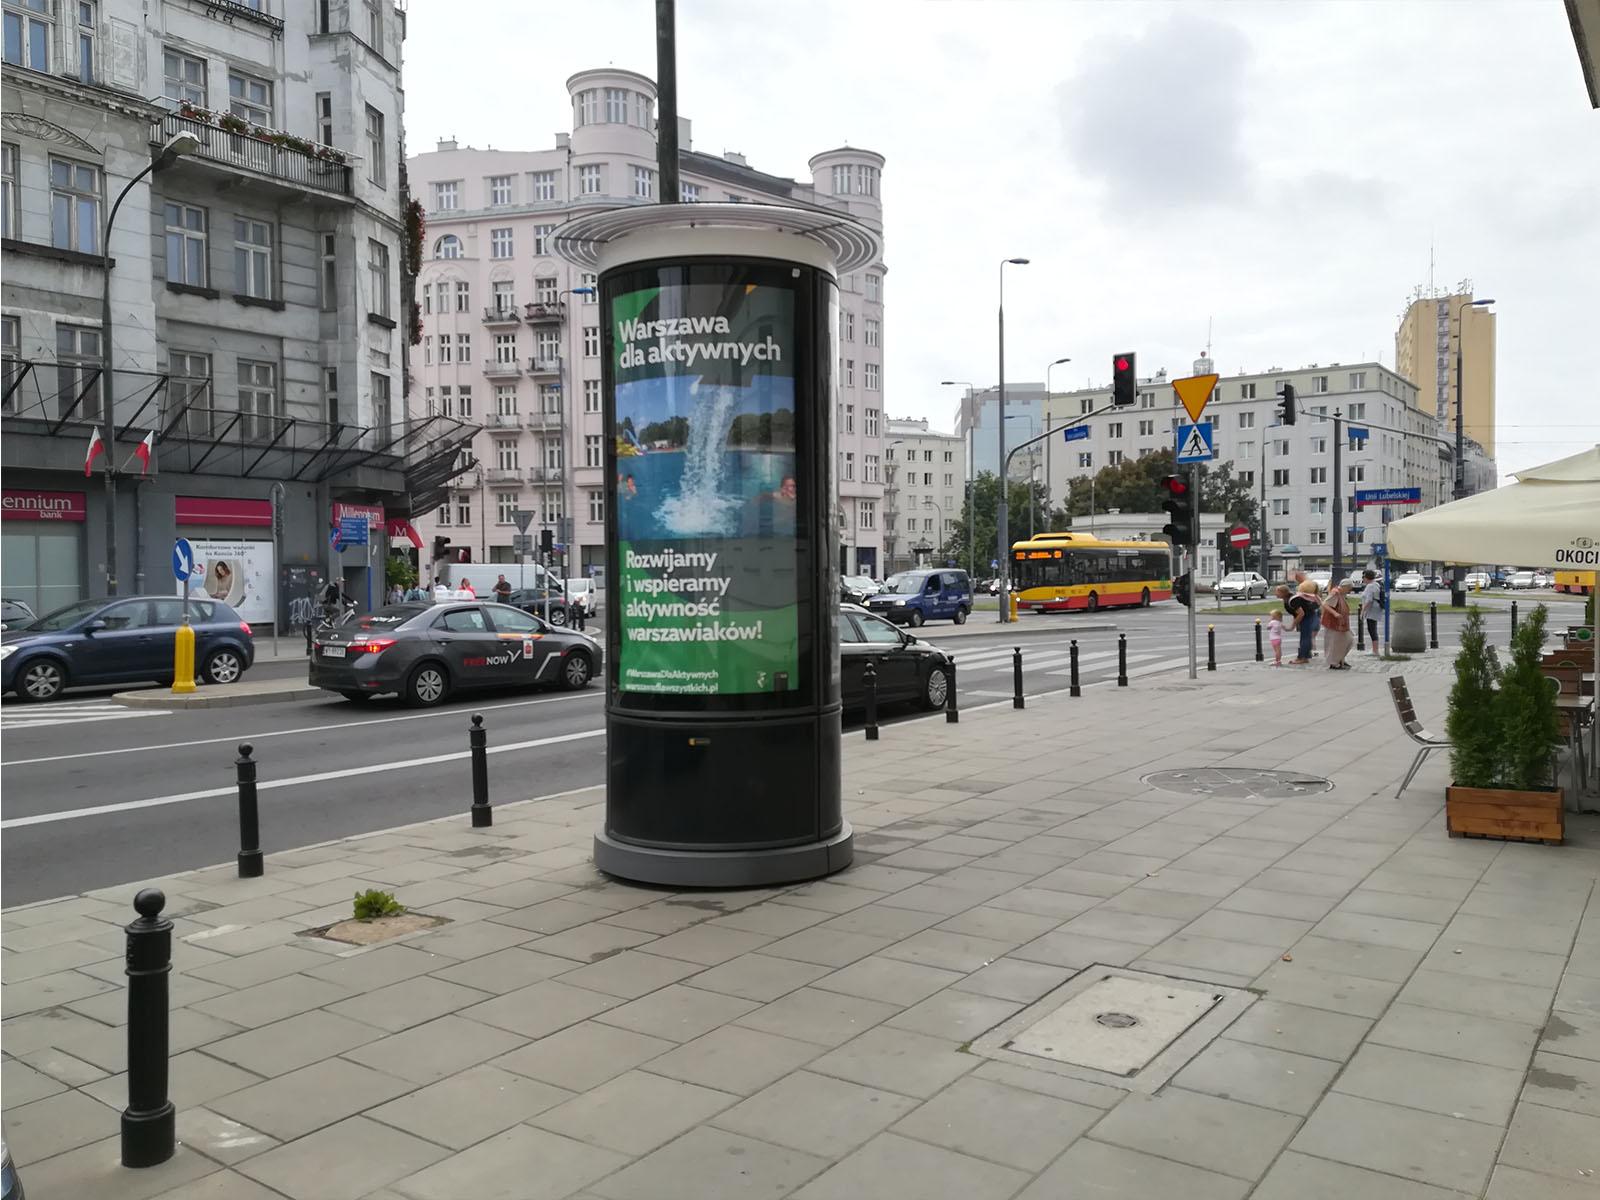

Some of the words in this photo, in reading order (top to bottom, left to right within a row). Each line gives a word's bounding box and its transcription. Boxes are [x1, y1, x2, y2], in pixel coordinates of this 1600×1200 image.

[619, 316, 730, 343] Warszawa
[619, 343, 645, 369] dla
[648, 335, 781, 367] aktywnych
[40, 510, 62, 518] bank
[626, 548, 718, 573] Rozwijamy
[626, 574, 632, 593] i
[633, 573, 731, 597] wspieramy
[626, 597, 720, 622] aktywność
[627, 620, 763, 642] warszawiaków!
